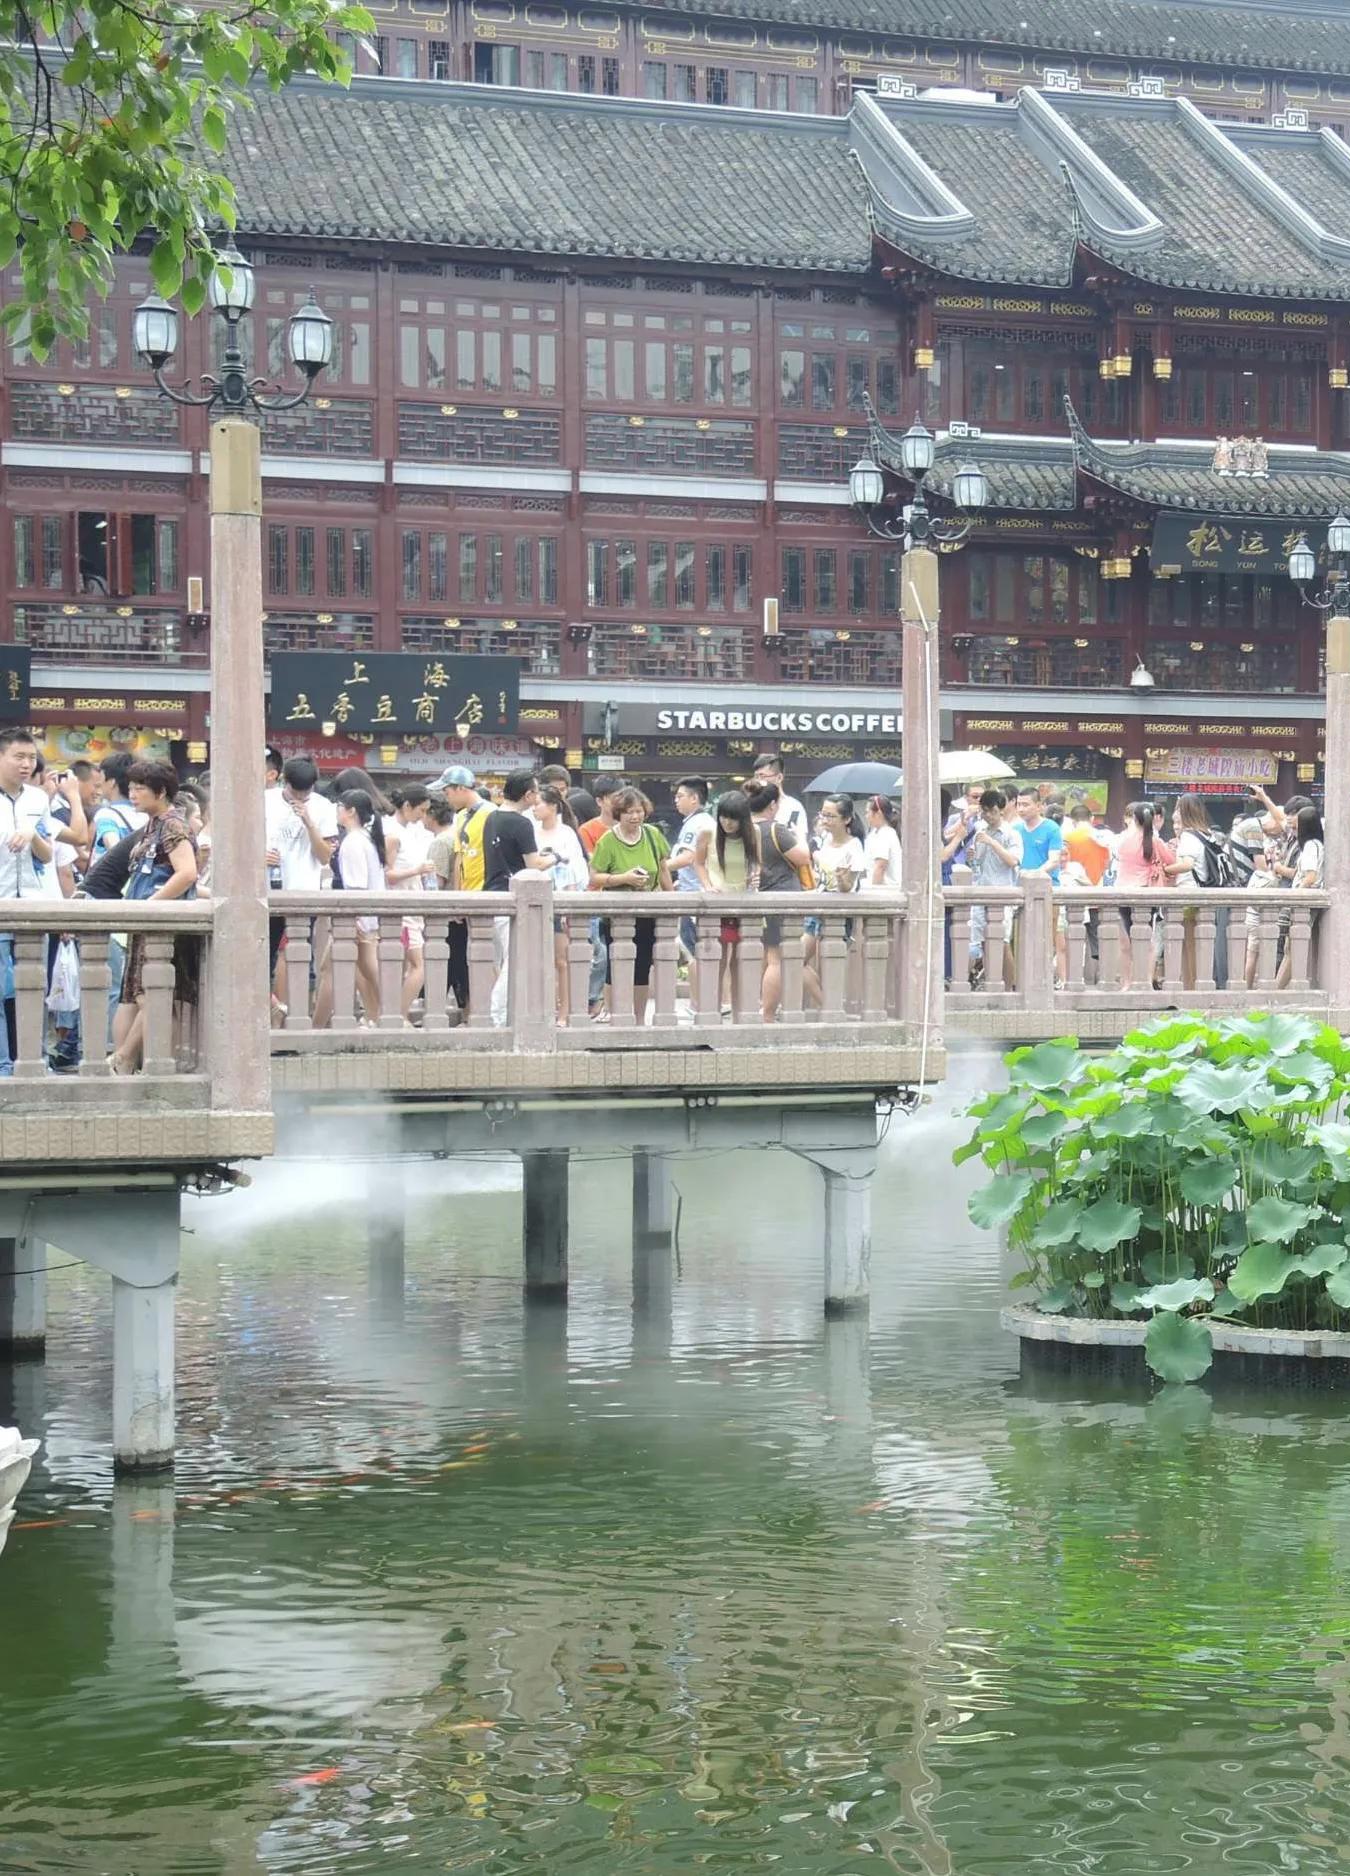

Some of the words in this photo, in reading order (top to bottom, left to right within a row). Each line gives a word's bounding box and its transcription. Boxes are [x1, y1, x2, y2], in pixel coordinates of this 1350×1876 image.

[1191, 559, 1219, 568] SONG
[1236, 561, 1257, 569] YUN
[343, 660, 451, 688] 上海
[285, 692, 484, 724] 五香豆商店
[657, 710, 813, 732] STARBUCKS
